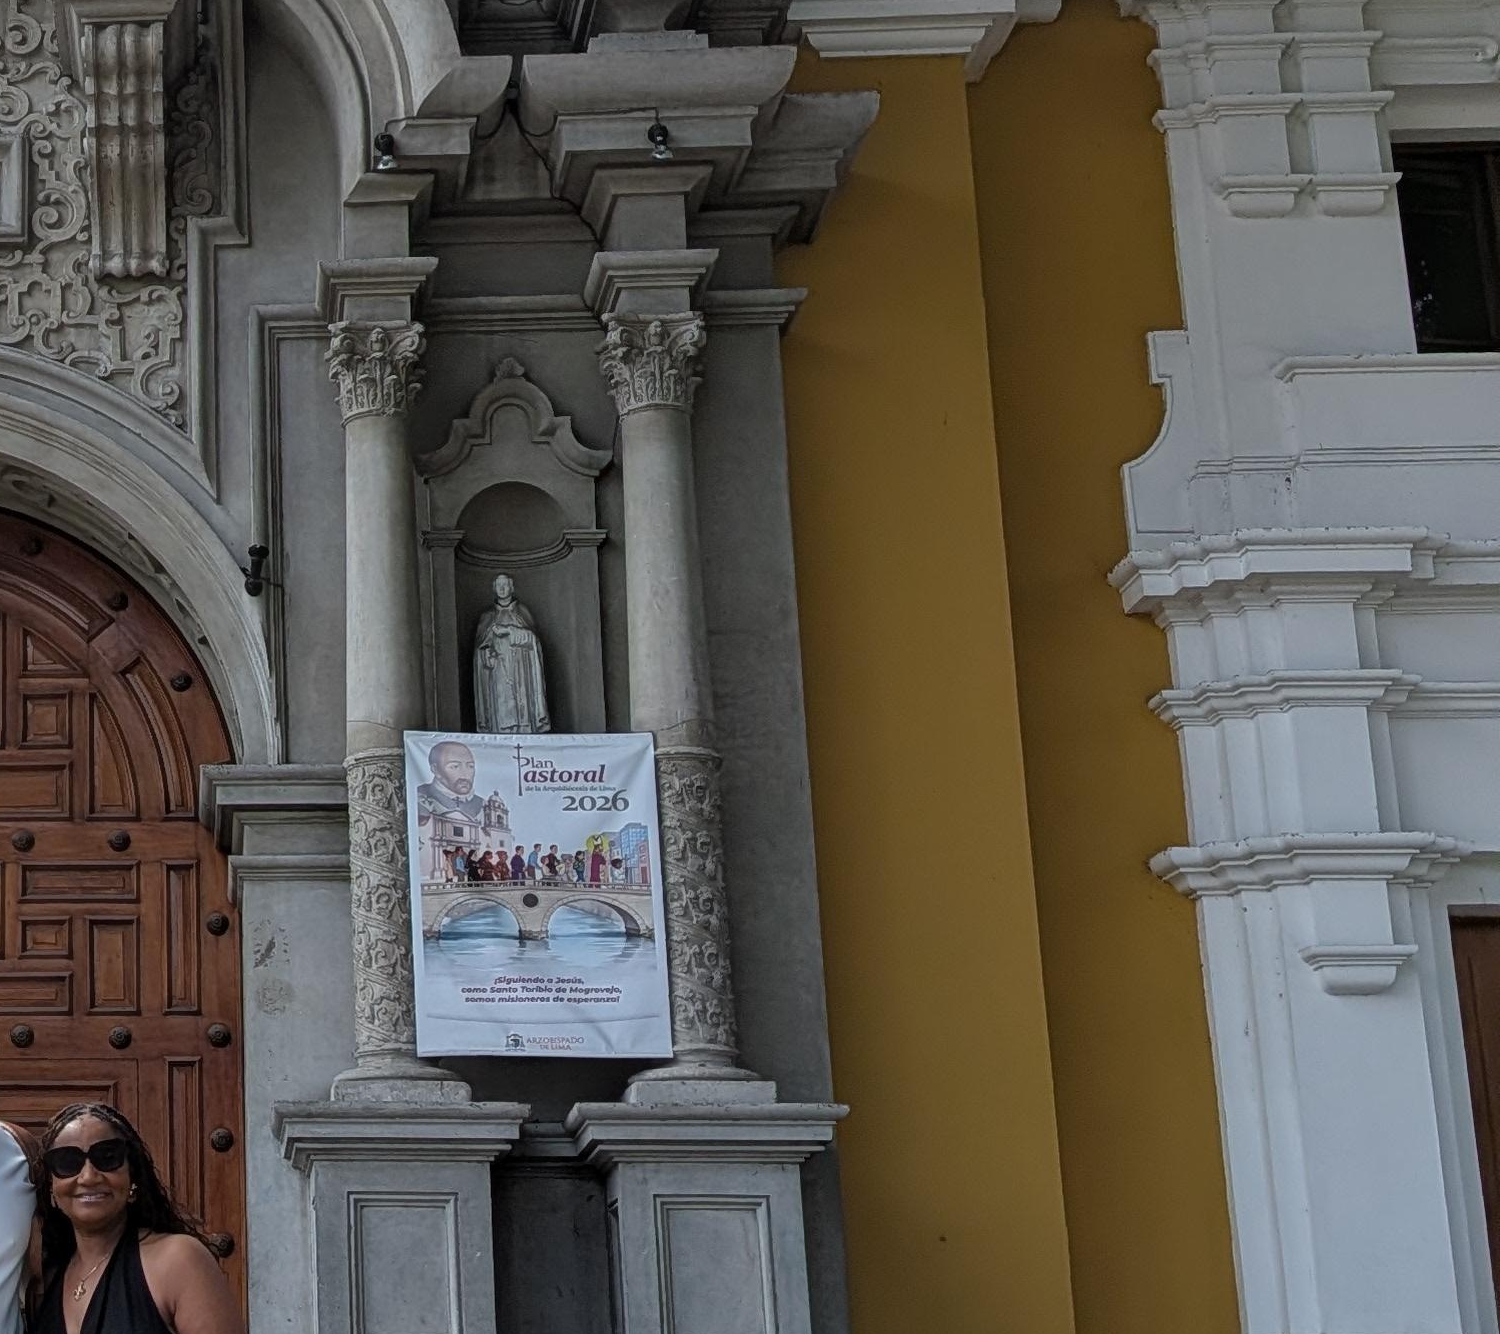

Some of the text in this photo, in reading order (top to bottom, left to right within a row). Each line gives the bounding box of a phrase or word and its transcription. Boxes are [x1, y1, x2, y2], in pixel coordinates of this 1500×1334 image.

[562, 789, 630, 812] 2026
[490, 986, 518, 994] Santo
[520, 985, 553, 993] Toribio
[555, 986, 567, 994] de
[498, 995, 551, 1003] misioneros
[553, 995, 565, 1003] de
[526, 1035, 585, 1044] ARZOBISPADO
